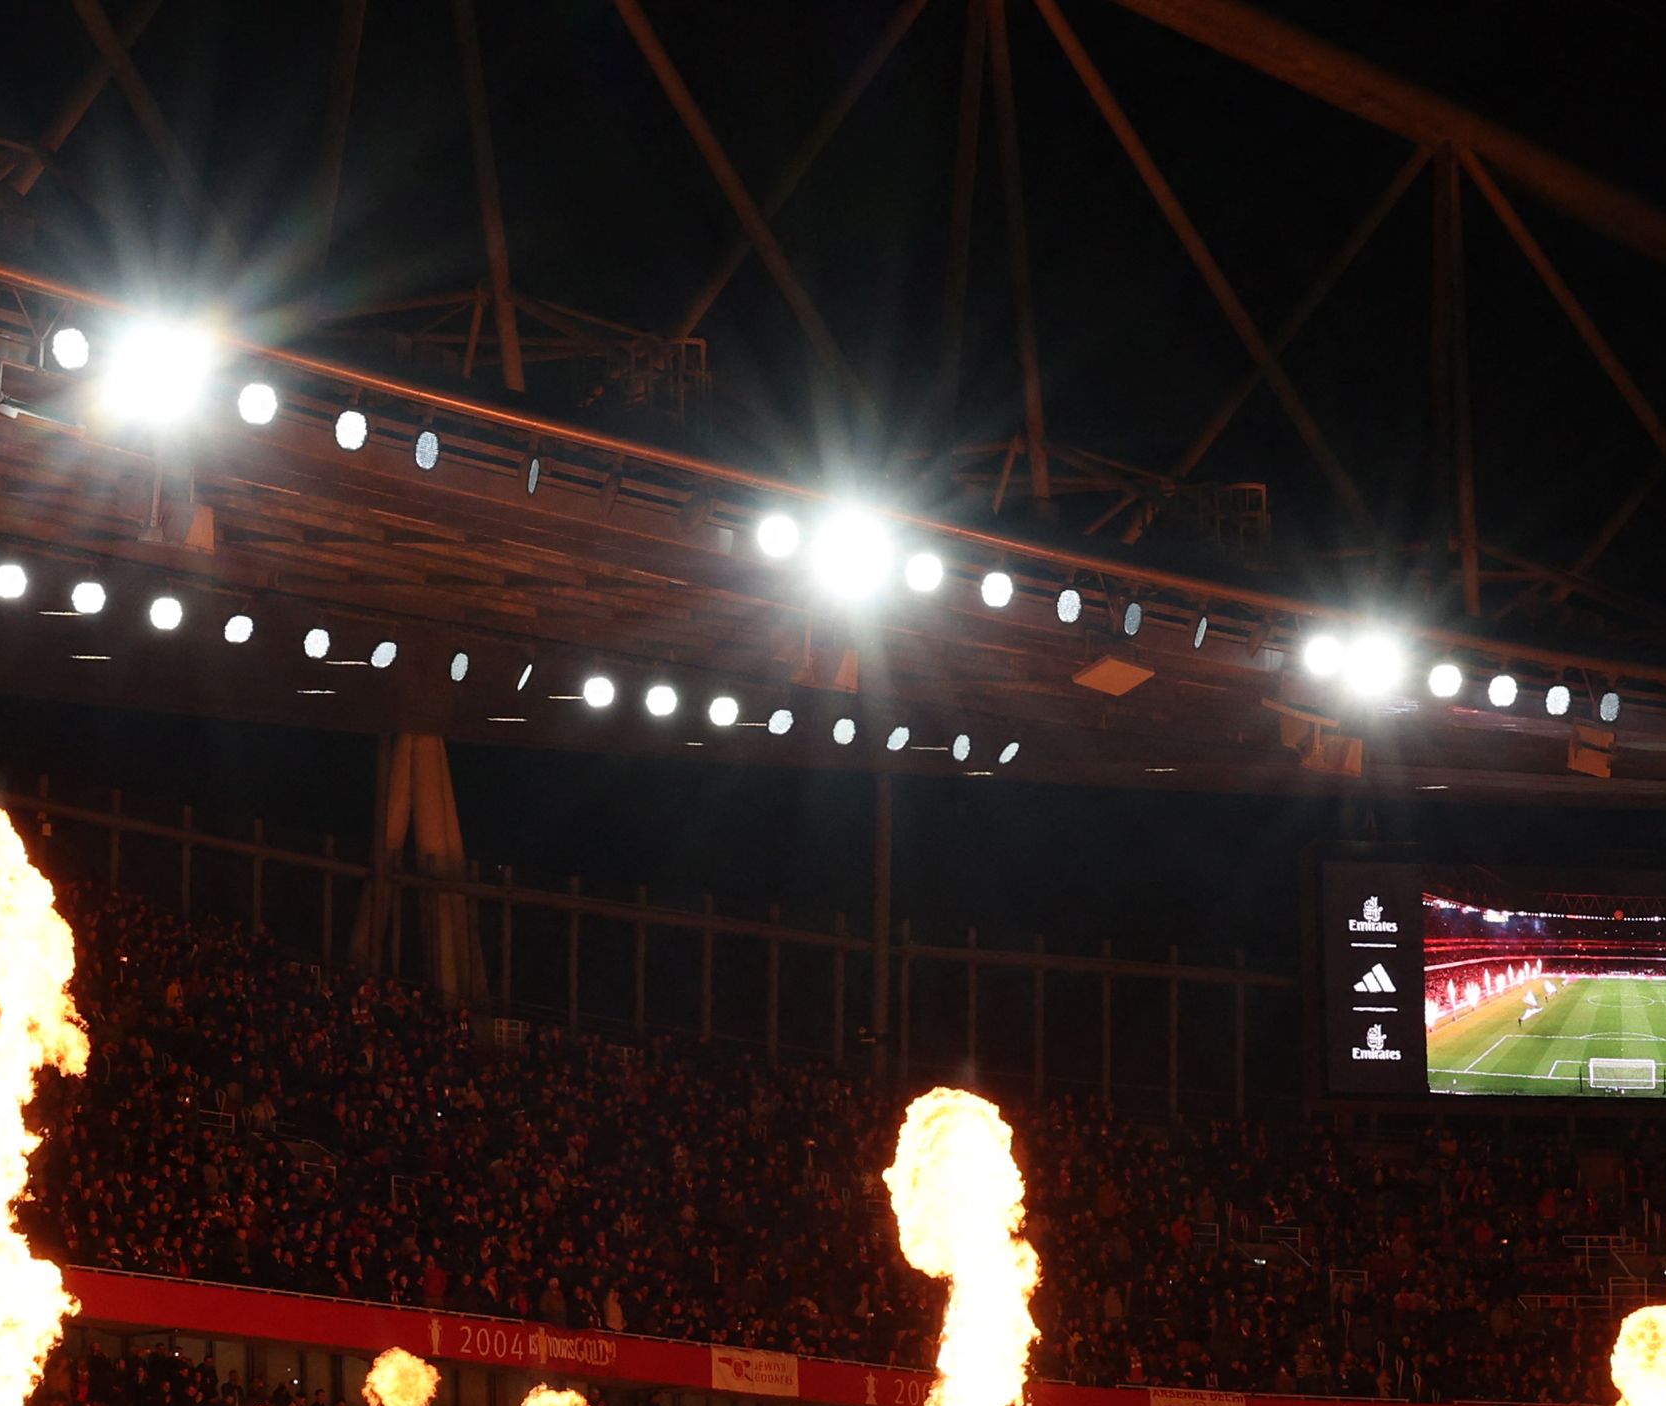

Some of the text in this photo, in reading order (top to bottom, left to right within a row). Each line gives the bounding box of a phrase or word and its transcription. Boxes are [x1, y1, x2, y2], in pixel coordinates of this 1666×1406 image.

[1349, 919, 1398, 932] Emirates
[1352, 1048, 1401, 1060] Emirates
[460, 1325, 523, 1360] 2004
[1153, 1389, 1206, 1400] ARSENAL
